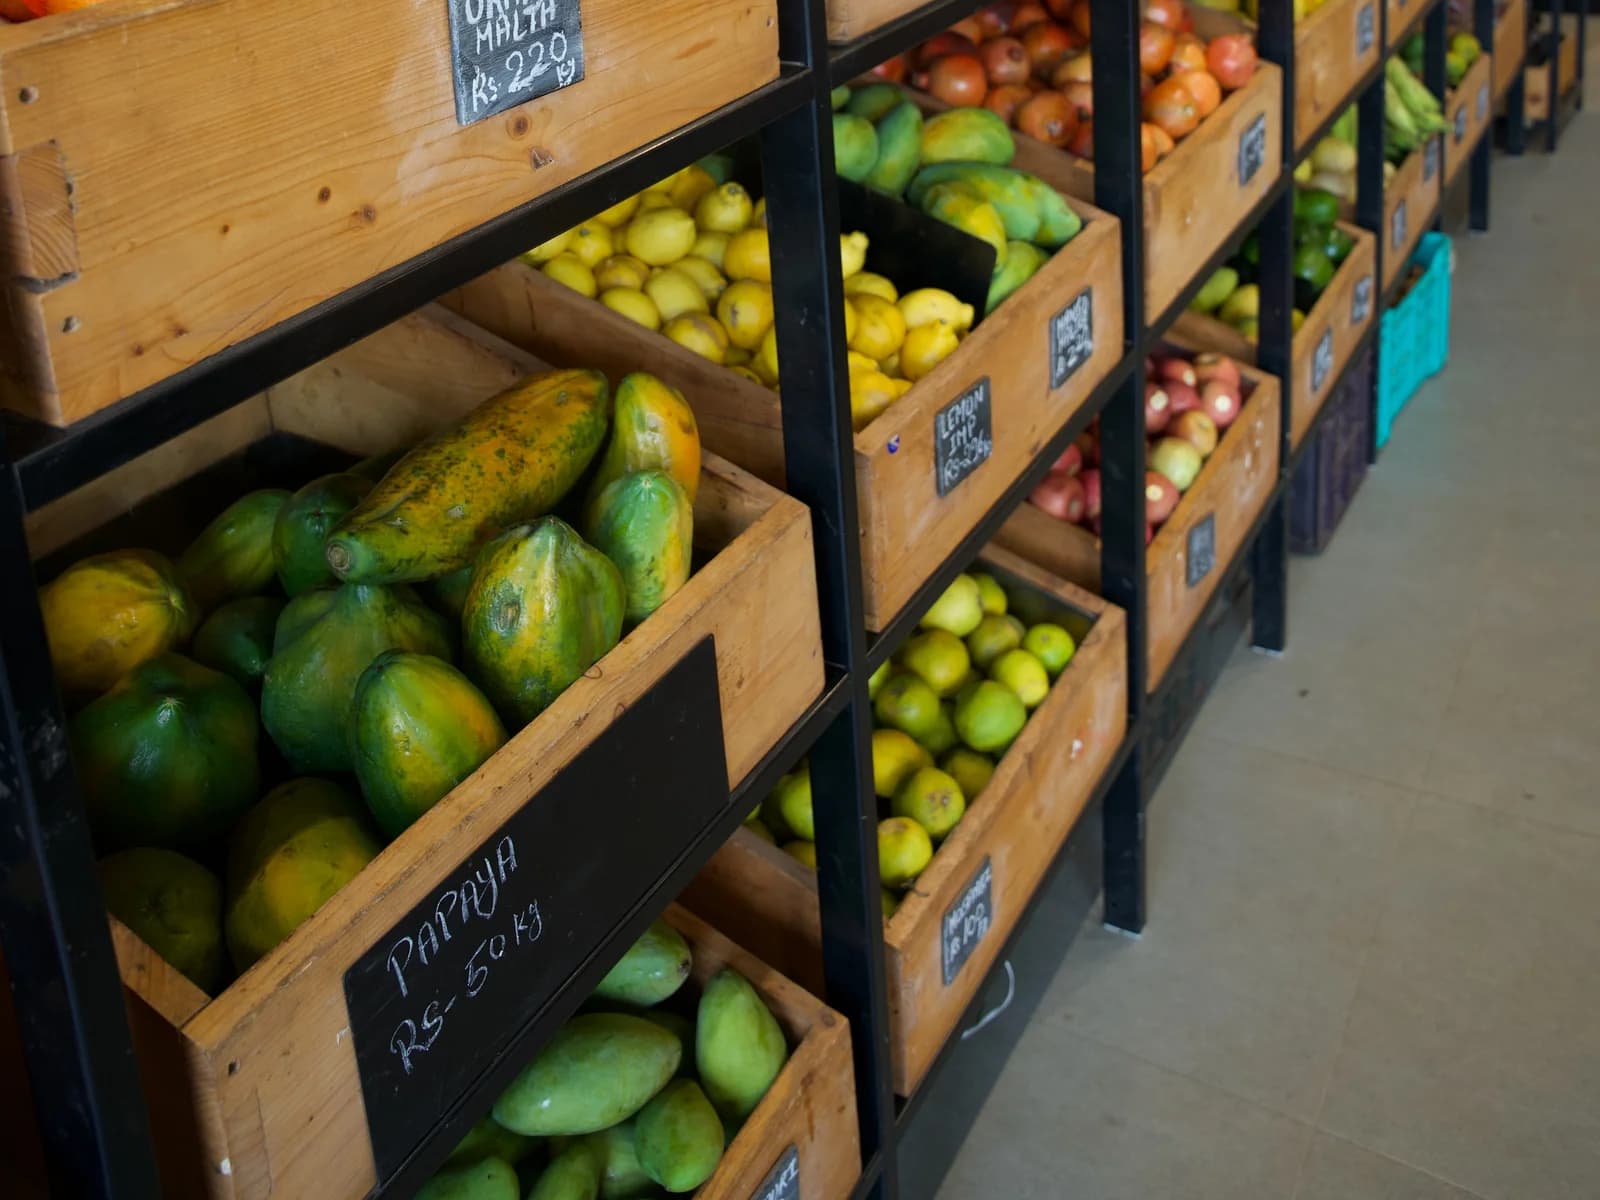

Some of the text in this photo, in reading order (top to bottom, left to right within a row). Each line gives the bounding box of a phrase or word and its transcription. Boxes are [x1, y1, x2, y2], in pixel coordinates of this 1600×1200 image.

[505, 31, 567, 94] 220
[941, 384, 984, 439] LEMON
[949, 414, 976, 456] IMP
[386, 835, 518, 998] PAPAYA
[464, 933, 506, 998] 50
